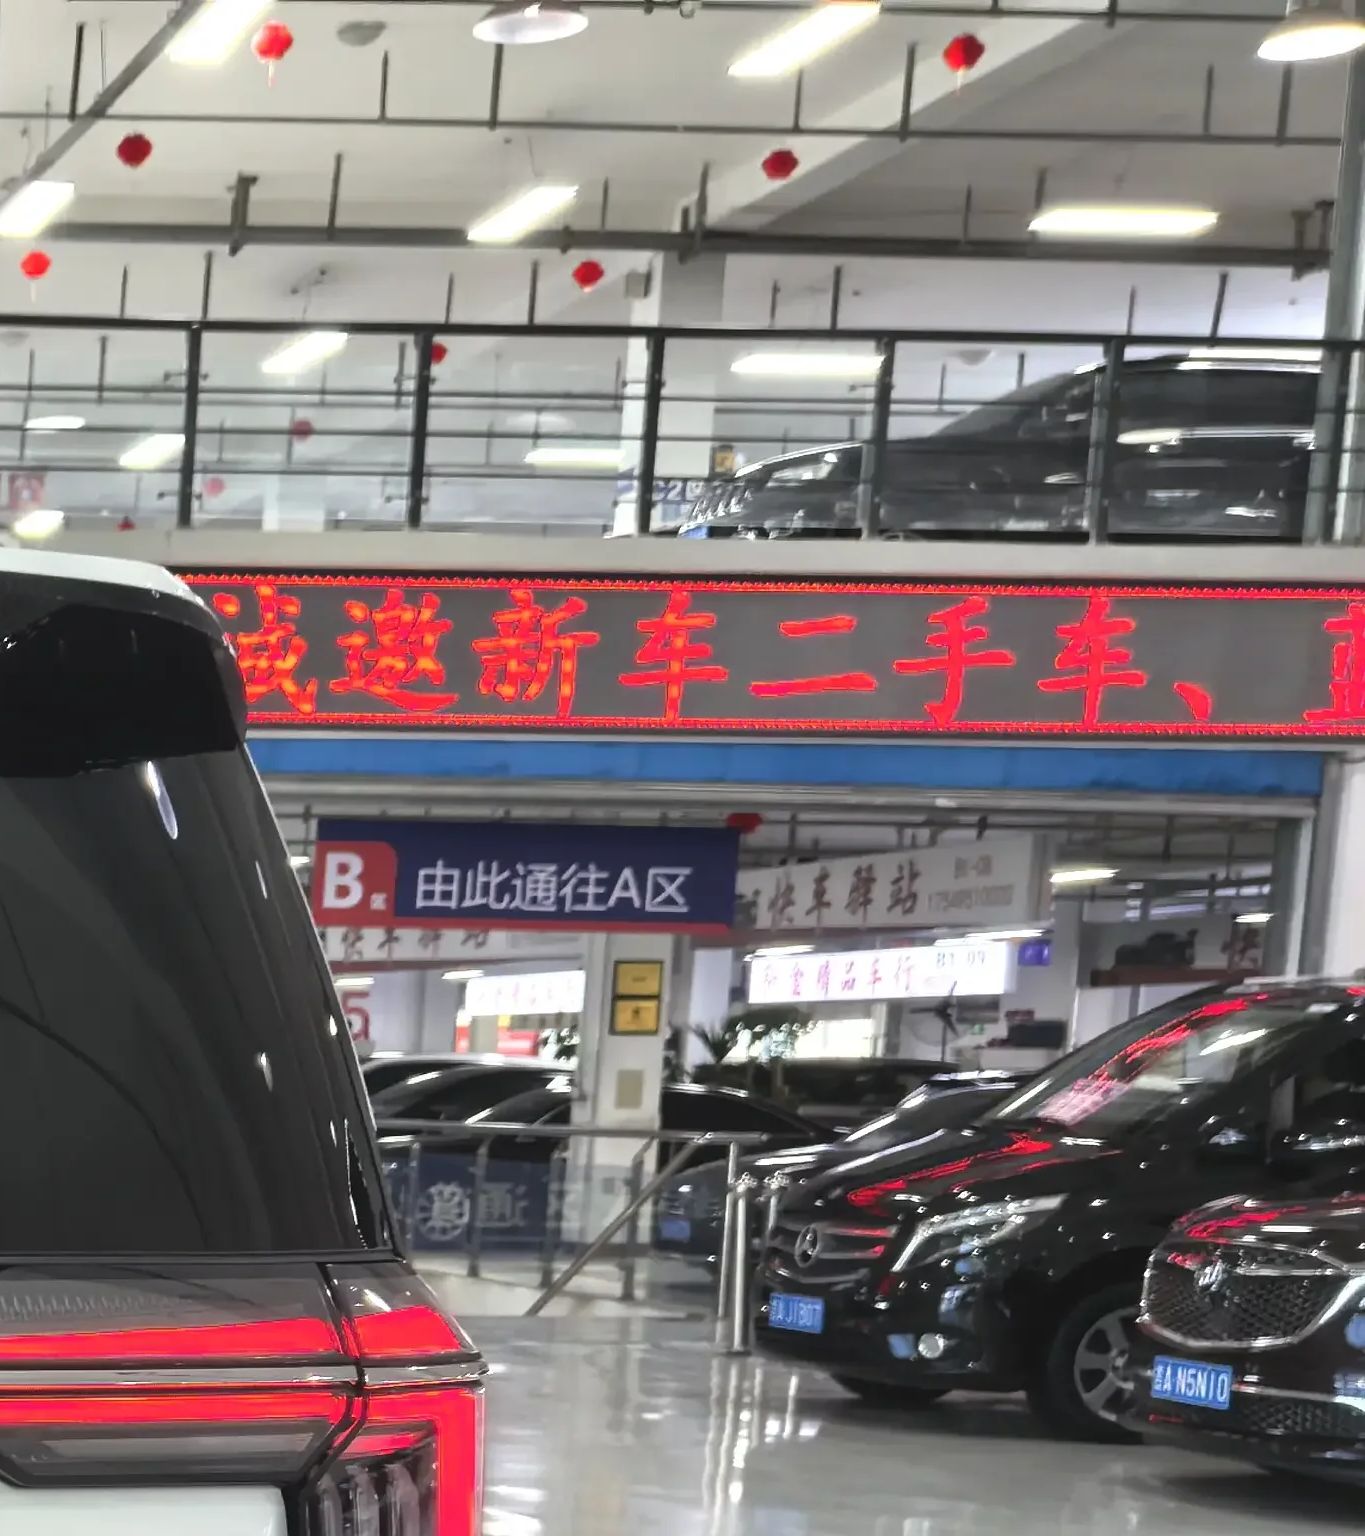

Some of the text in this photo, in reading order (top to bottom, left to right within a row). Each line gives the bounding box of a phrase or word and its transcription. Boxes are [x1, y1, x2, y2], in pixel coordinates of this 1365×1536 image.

[415, 858, 693, 914] 由此通往A区
